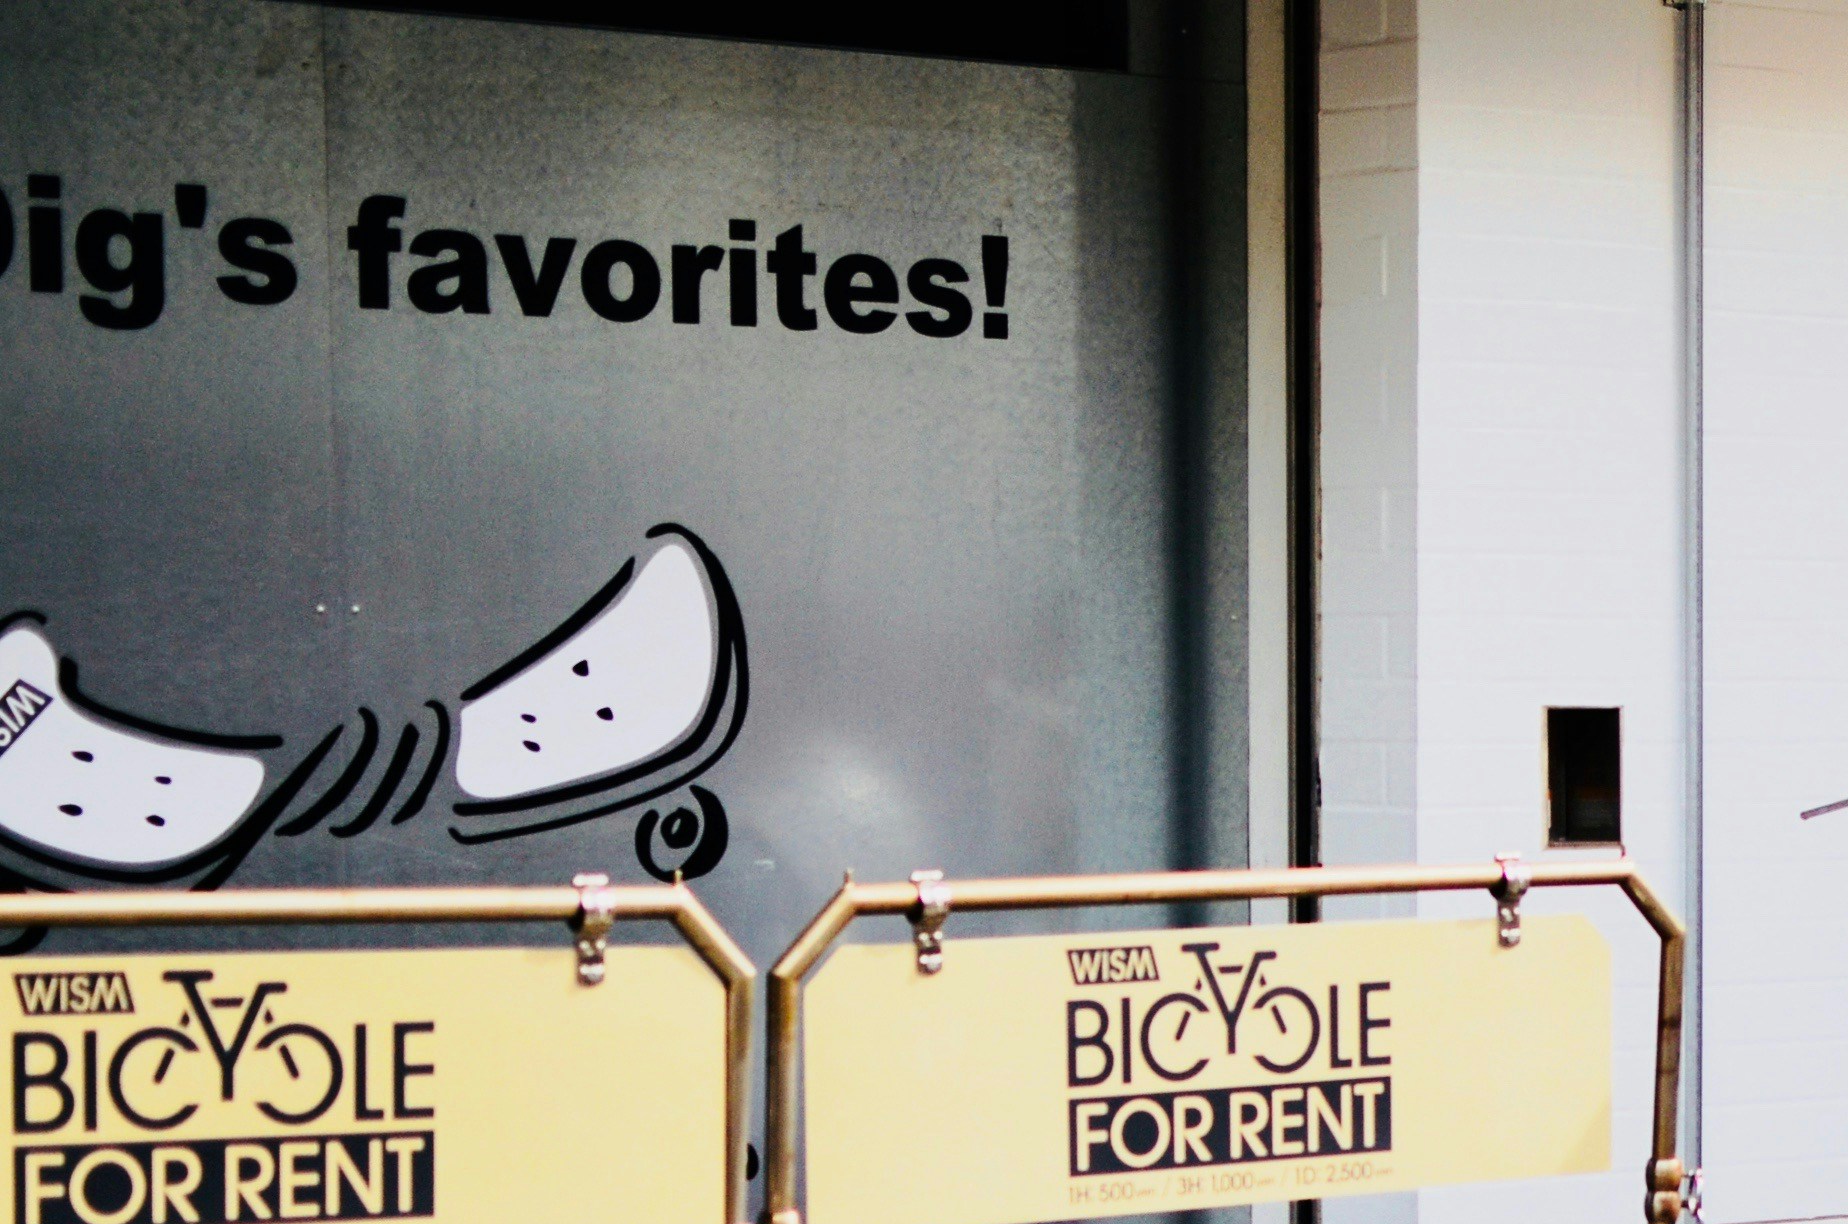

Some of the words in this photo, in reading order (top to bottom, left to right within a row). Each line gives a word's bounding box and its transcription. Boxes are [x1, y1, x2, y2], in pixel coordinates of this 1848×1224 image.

[0, 174, 298, 330] ig's
[347, 195, 1009, 340] favorites!
[18, 973, 131, 1014] WISM
[1070, 947, 1157, 983] WISM
[13, 970, 435, 1134] BICYCLE
[1067, 943, 1391, 1088] BICYCLE
[1075, 1094, 1213, 1172] FOR
[1229, 1081, 1386, 1159] RENT
[224, 1137, 426, 1222] RENT
